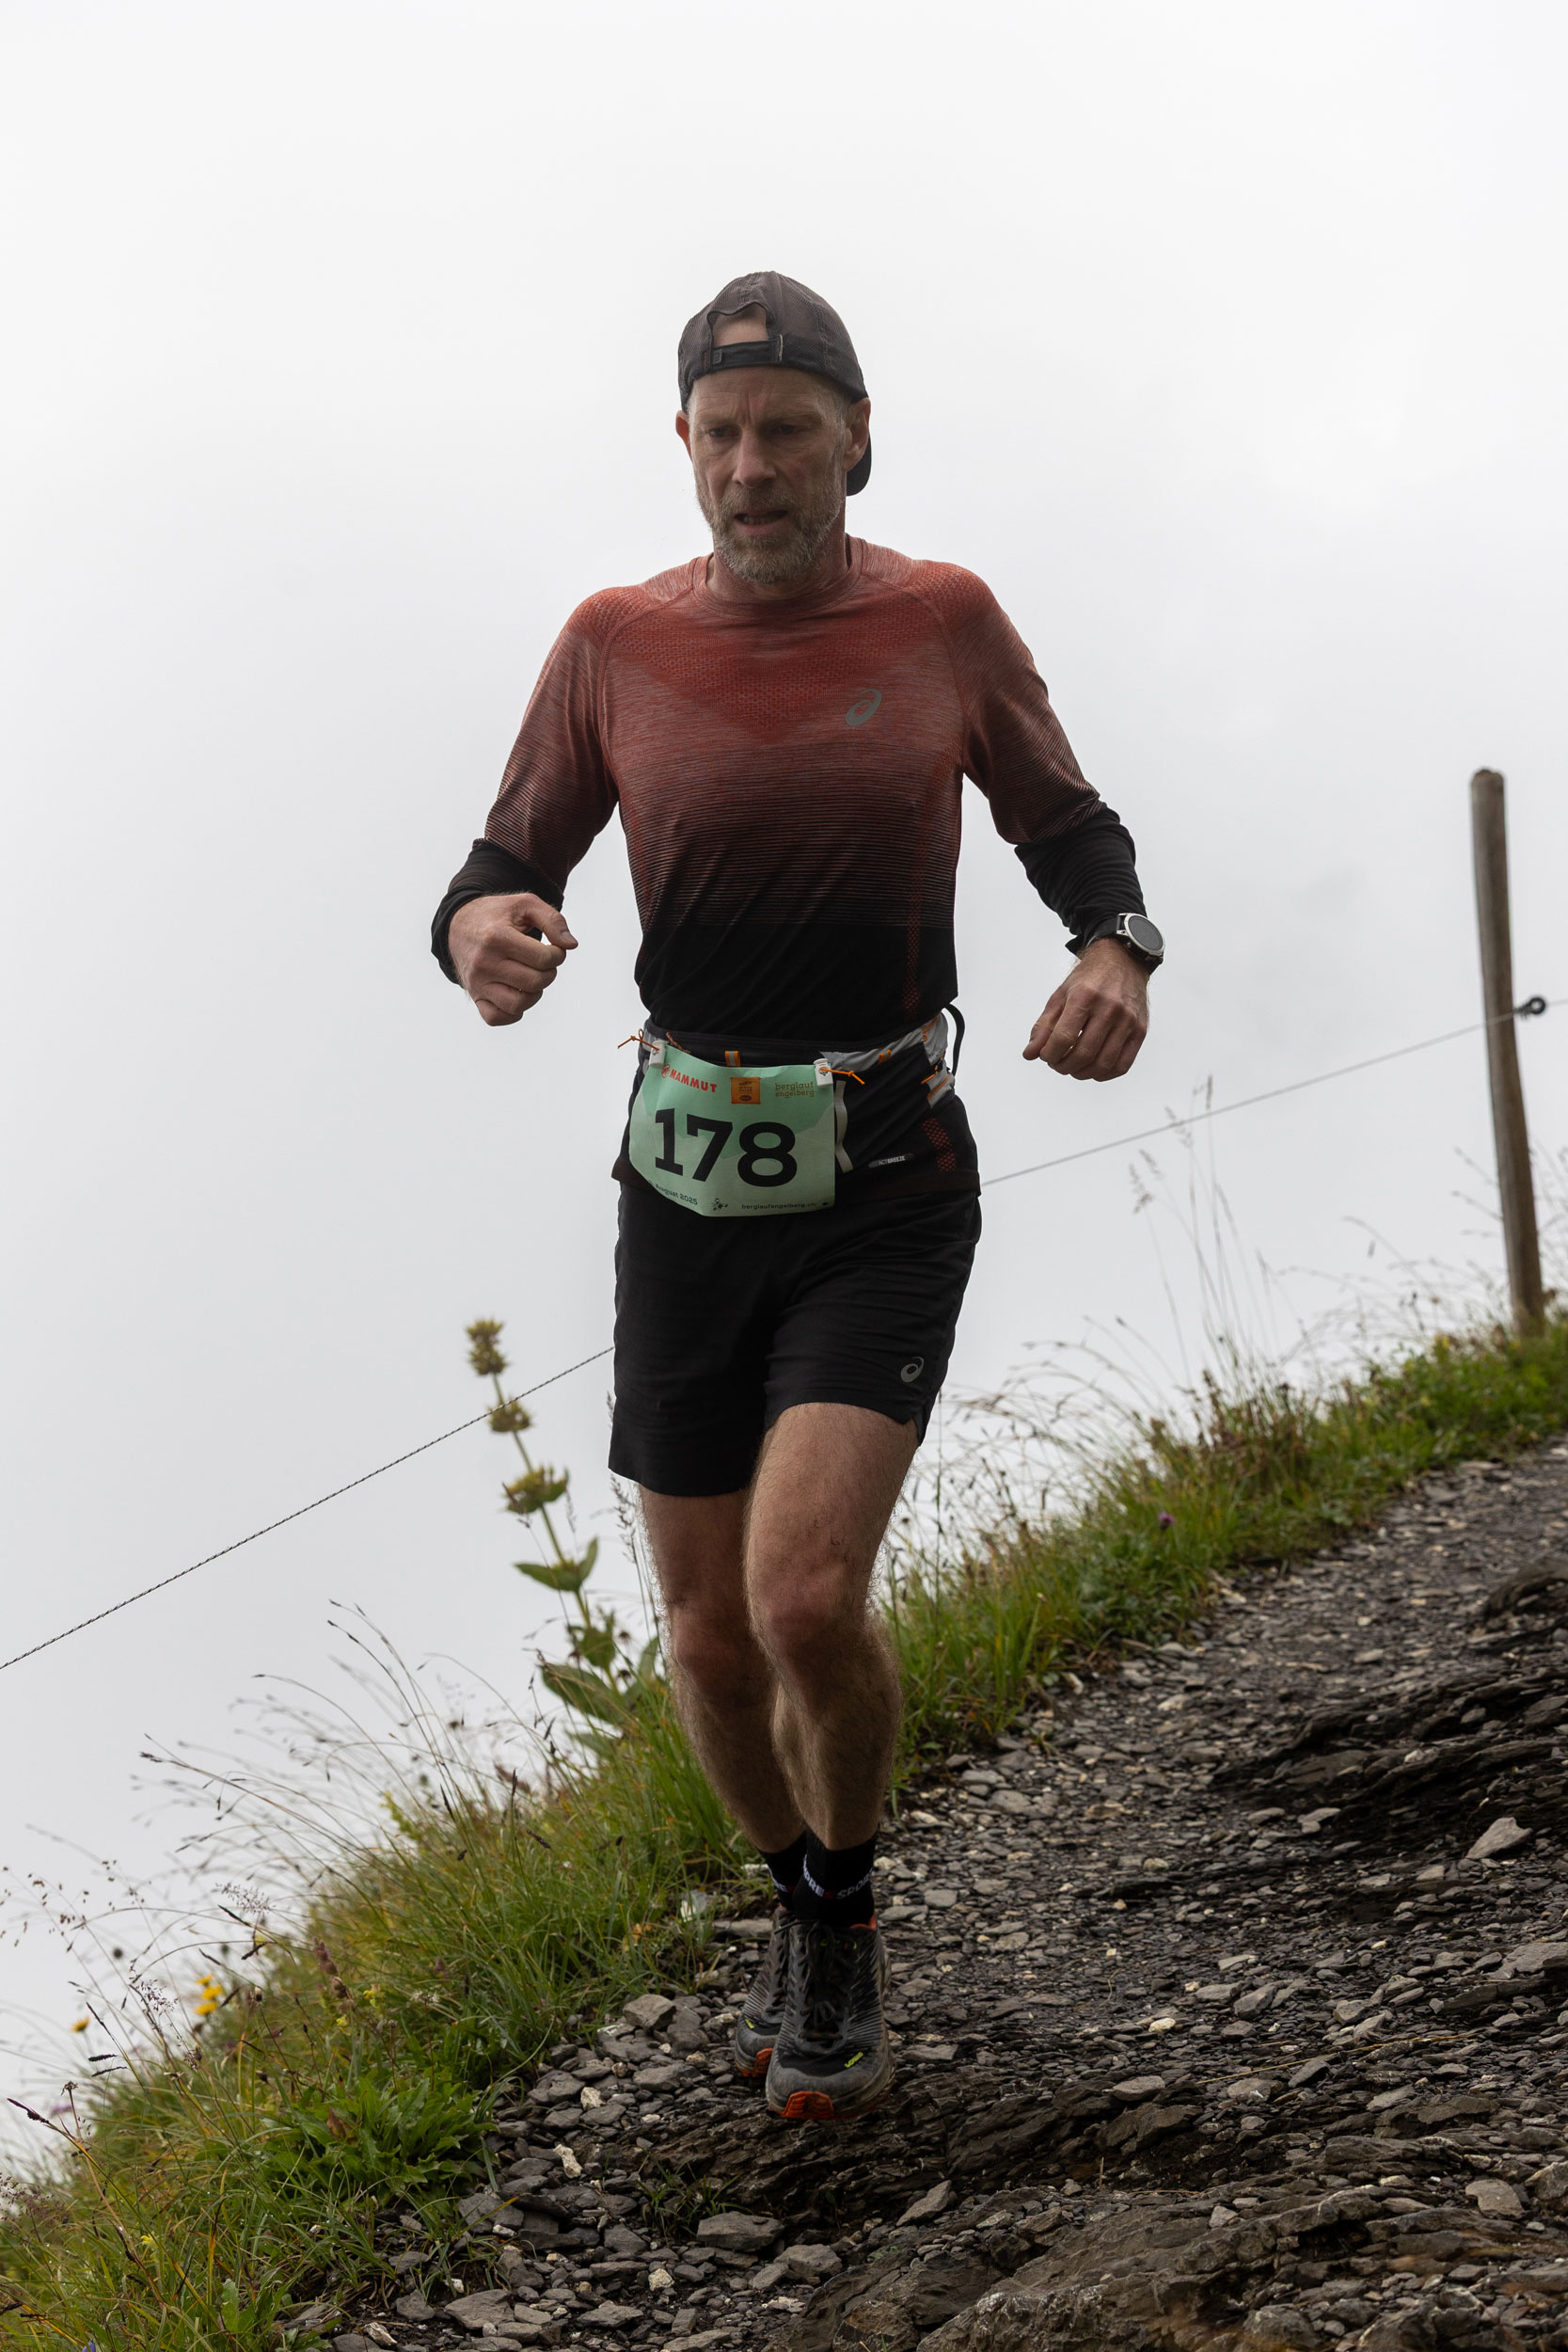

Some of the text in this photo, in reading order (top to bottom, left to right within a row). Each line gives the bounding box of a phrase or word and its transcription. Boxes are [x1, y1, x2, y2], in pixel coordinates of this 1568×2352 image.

[669, 1069, 718, 1092] MAMMUT
[774, 1081, 814, 1091] berglauf
[774, 1089, 815, 1099] engelberg
[654, 1107, 798, 1188] 178
[679, 1193, 699, 1206] 2025
